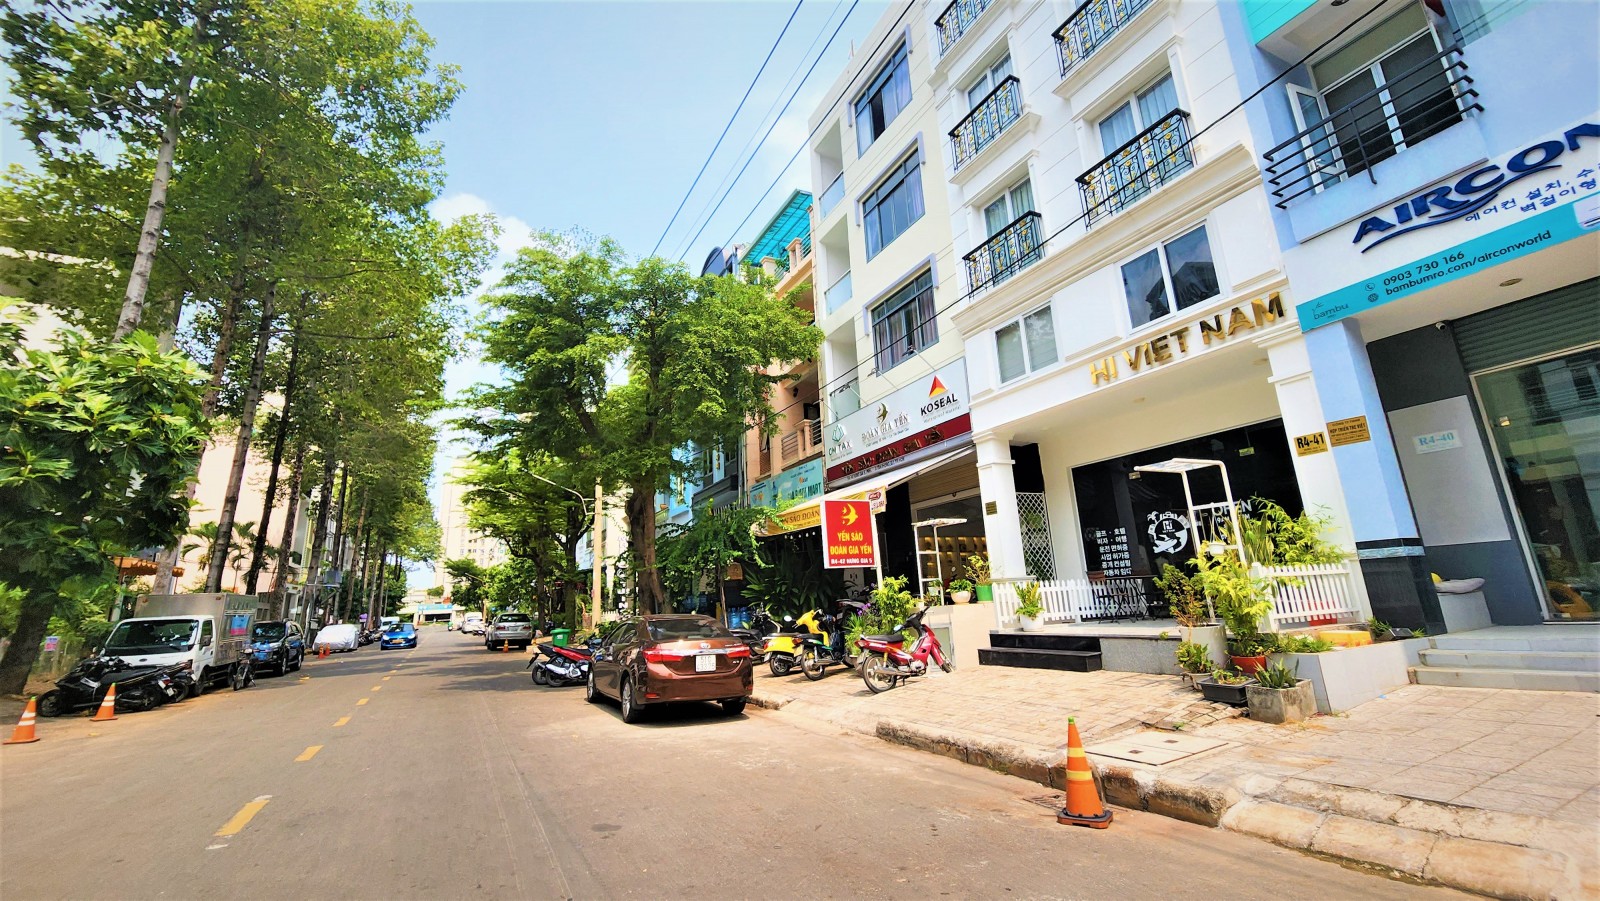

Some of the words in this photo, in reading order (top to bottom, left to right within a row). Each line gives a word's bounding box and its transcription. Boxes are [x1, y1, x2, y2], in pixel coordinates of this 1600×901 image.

[1352, 123, 1600, 244] AIRCON
[1465, 198, 1517, 222] 에어컨
[1576, 163, 1600, 179] 수
[1383, 270, 1413, 287] 0903
[1417, 260, 1440, 276] 730
[1443, 250, 1466, 267] 166
[1385, 230, 1552, 297] bambumro.com/airconworld
[1313, 302, 1350, 320] bambu
[1088, 355, 1119, 386] HI
[1122, 326, 1190, 372] VIET
[1199, 291, 1285, 345] NAM
[920, 393, 959, 417] KOSEAL
[1296, 433, 1325, 449] R4-41
[1418, 433, 1455, 446] R4-40
[837, 529, 850, 542] YẾN
[851, 530, 863, 542] SÀO
[830, 543, 848, 555] ĐOÀN
[848, 545, 859, 555] GIA
[860, 542, 872, 555] YẾN
